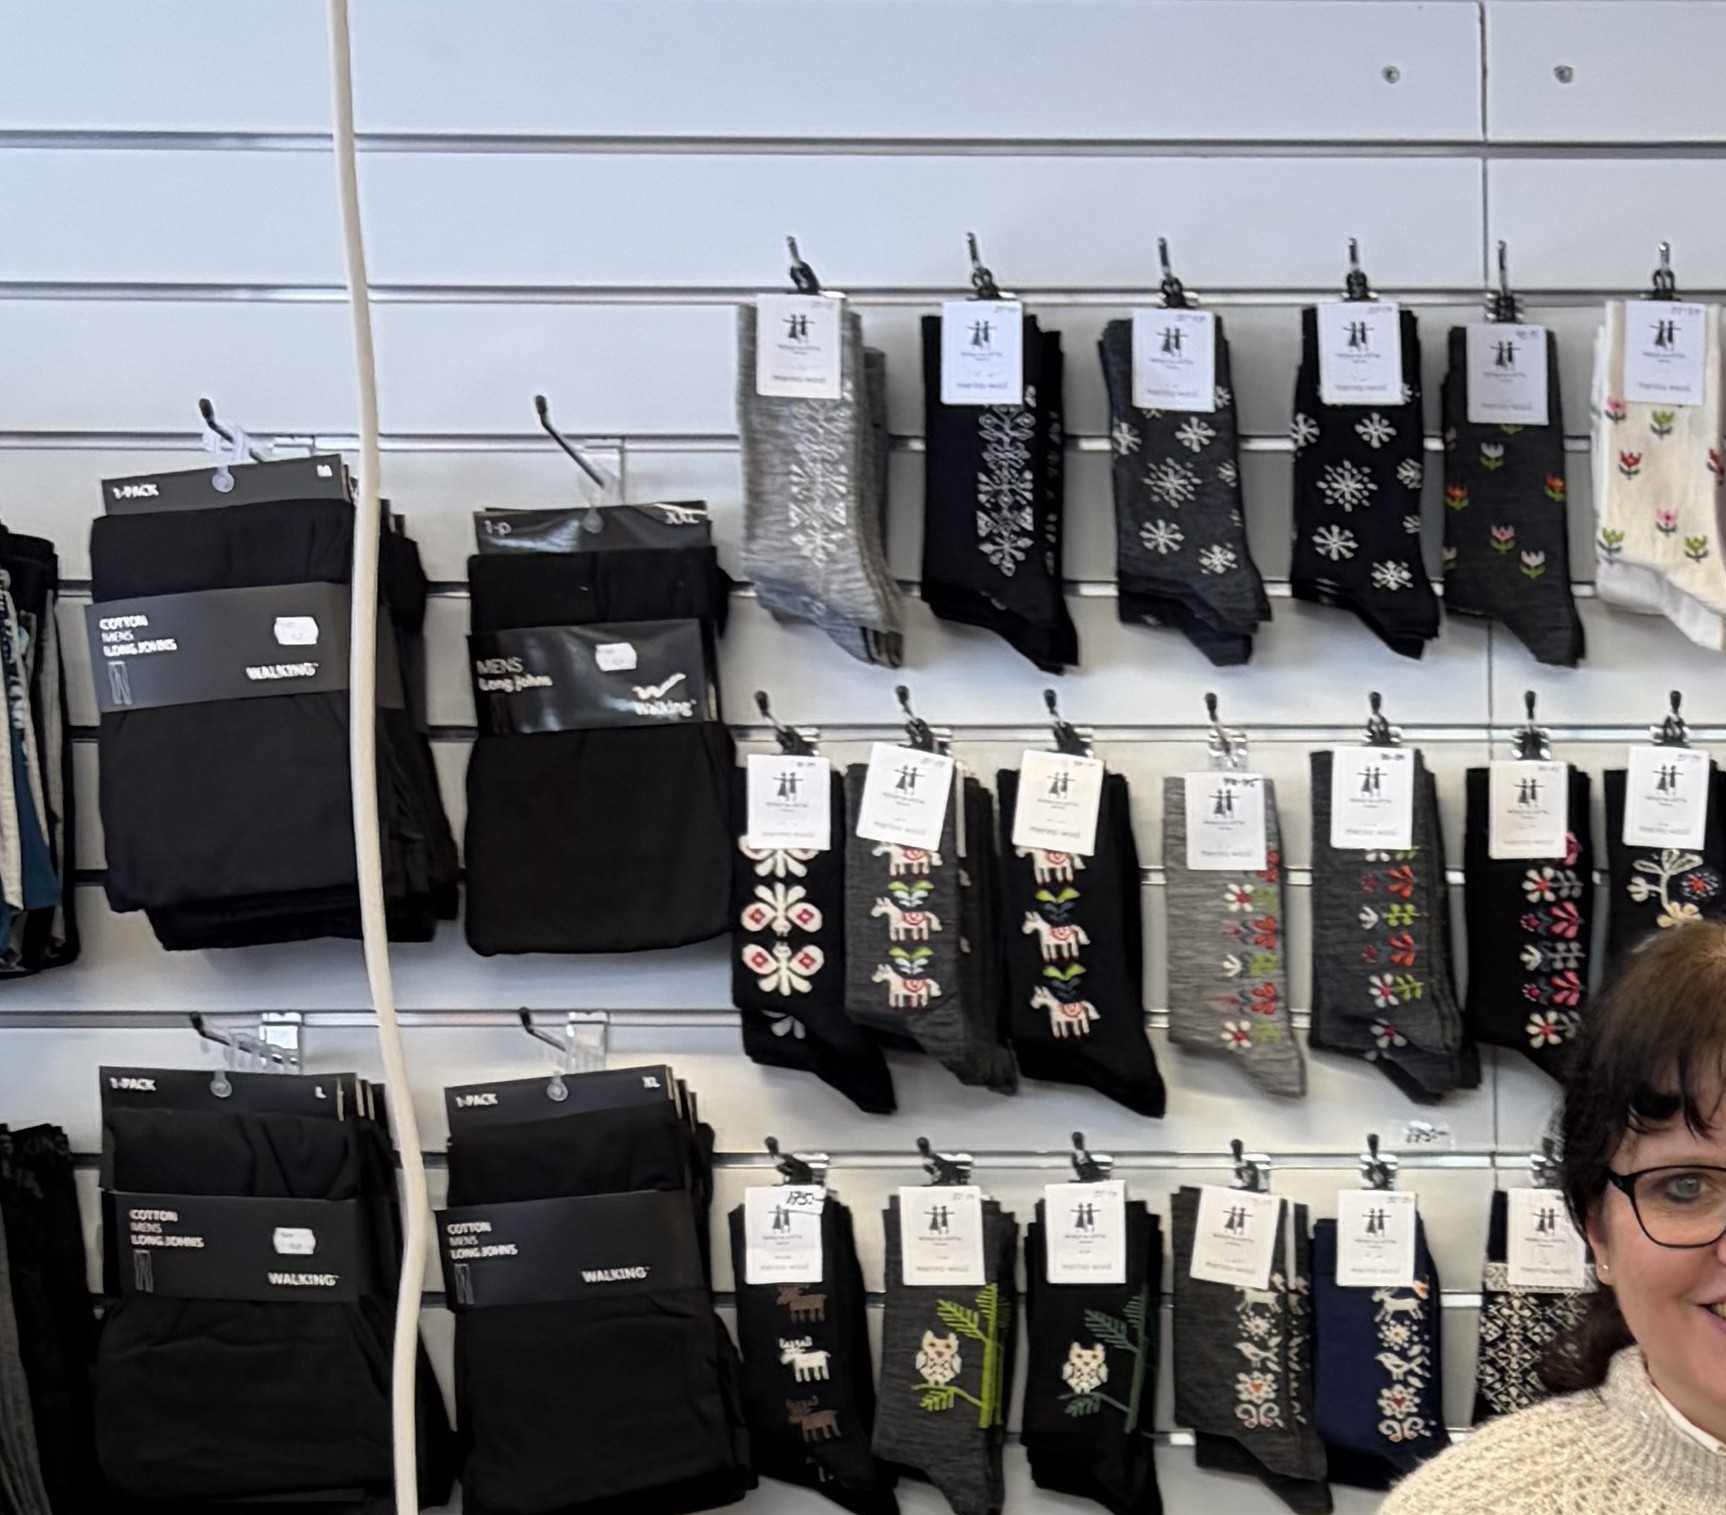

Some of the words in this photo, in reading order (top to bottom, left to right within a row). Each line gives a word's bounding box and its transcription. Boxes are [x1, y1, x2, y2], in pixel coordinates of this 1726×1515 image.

[112, 484, 159, 499] 1-PACK
[99, 615, 149, 630] COTTON
[101, 630, 134, 642] MENS
[103, 641, 137, 656] LONG
[246, 662, 316, 680] WALKING
[476, 656, 524, 674] MENS
[478, 676, 513, 692] Long
[109, 1077, 157, 1091] 1-PACK
[456, 1093, 498, 1108] 1-PACK
[129, 1209, 178, 1222] COTTON
[447, 1221, 492, 1235] COTTON
[130, 1234, 164, 1246] LONG
[165, 1235, 205, 1248] JOHNS
[450, 1247, 481, 1260] LONG
[482, 1244, 518, 1258] JOHNS
[267, 1272, 337, 1287] WALKING
[581, 1266, 647, 1283] WALKING
